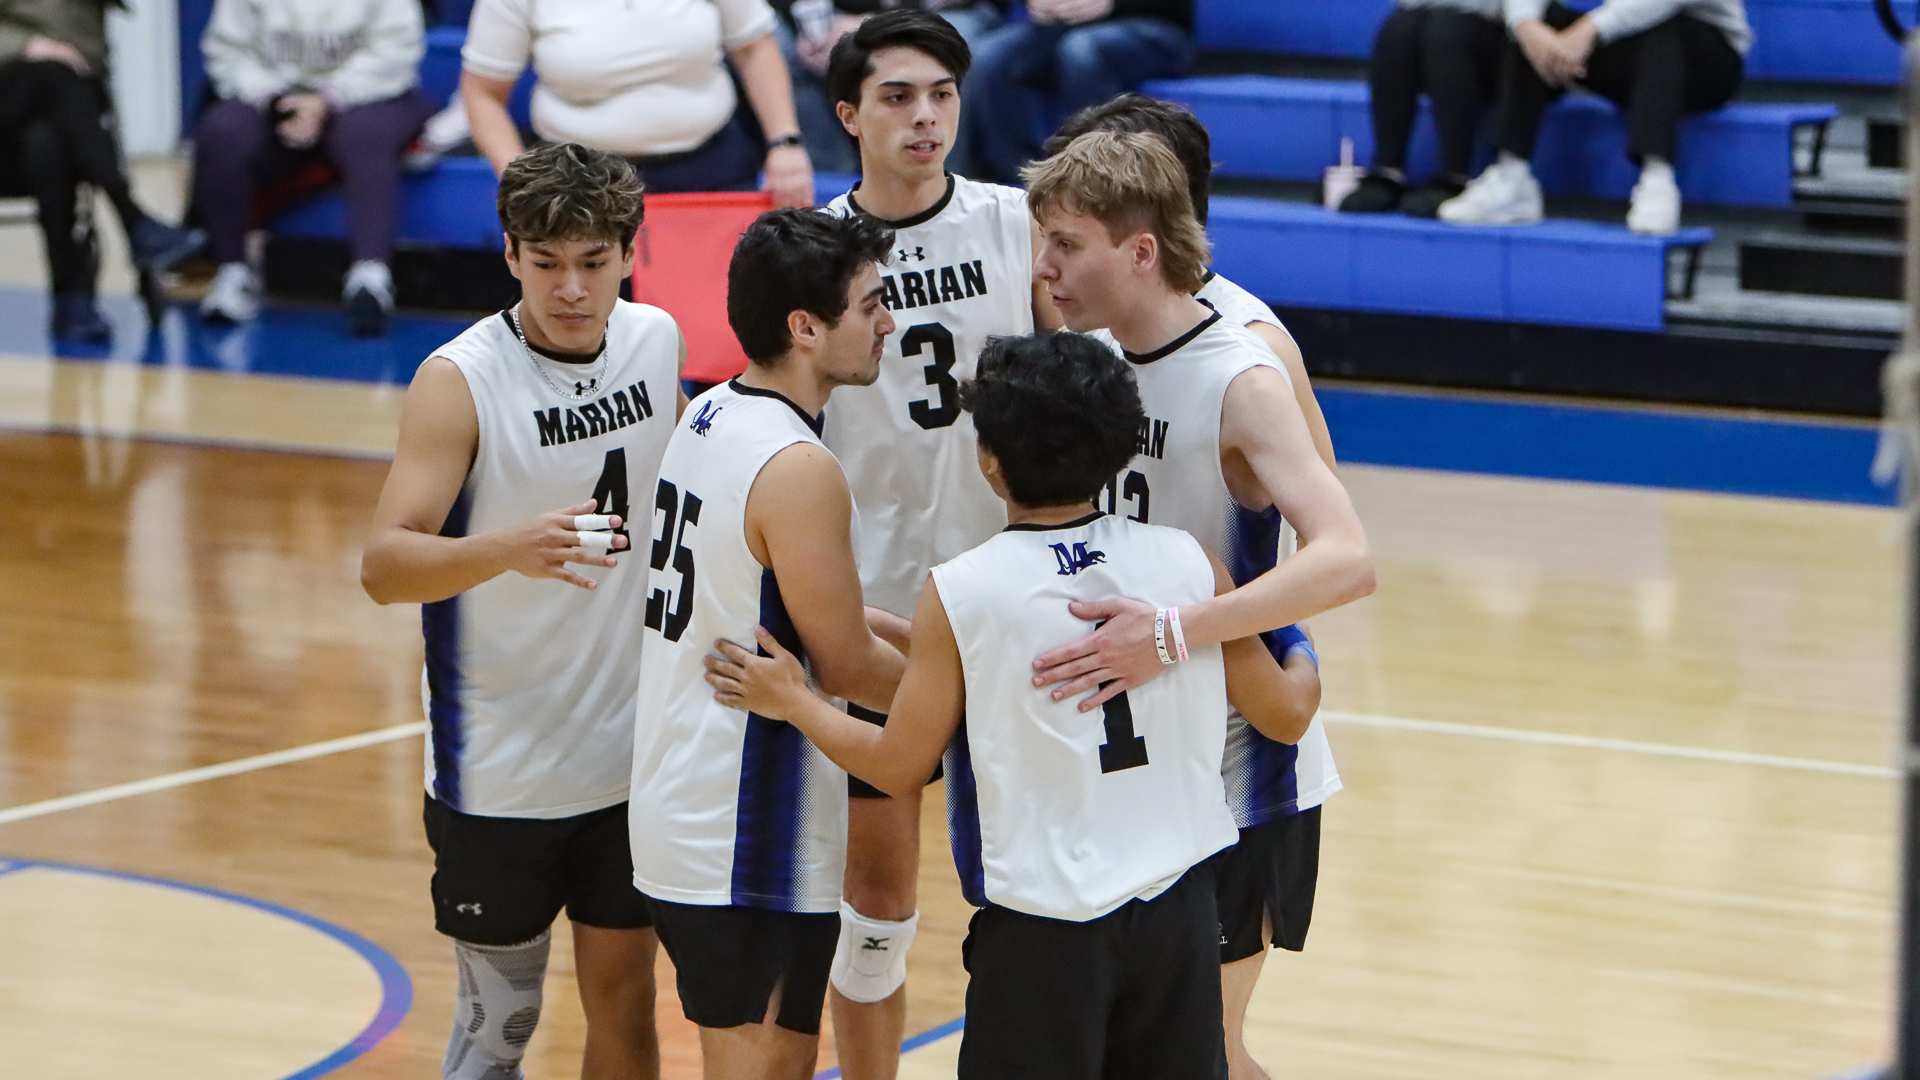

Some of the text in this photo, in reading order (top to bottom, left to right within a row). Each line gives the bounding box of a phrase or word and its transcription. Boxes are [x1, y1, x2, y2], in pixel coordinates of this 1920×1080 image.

[880, 259, 988, 312] ARIAN
[533, 379, 654, 448] MARIAN
[900, 321, 962, 431] 3
[580, 446, 632, 556] 4
[644, 477, 703, 643] 25
[1094, 619, 1150, 775] 1
